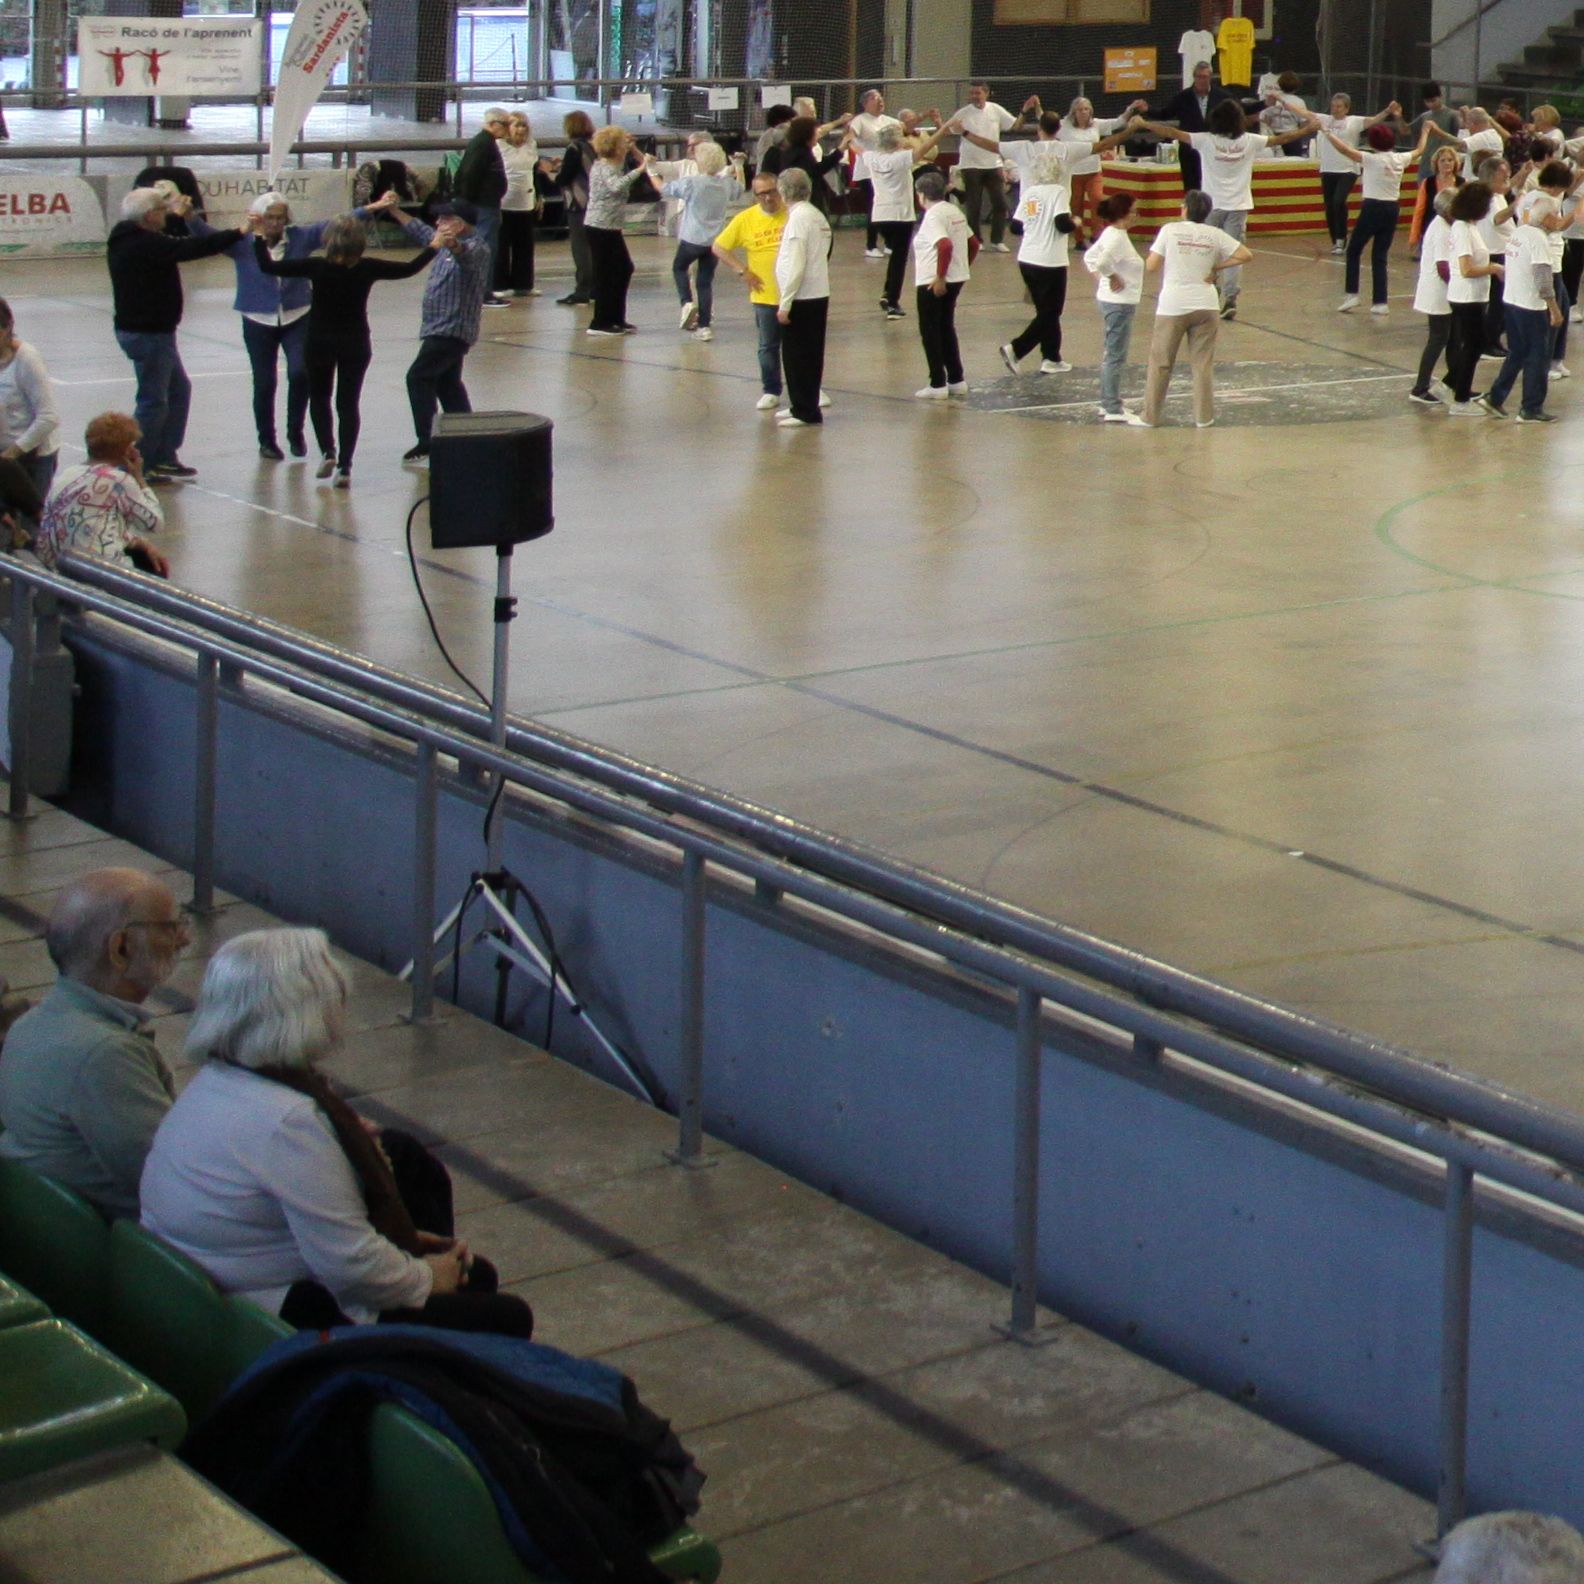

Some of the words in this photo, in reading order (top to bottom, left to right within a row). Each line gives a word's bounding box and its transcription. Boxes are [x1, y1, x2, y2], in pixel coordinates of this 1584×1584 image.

[121, 26, 157, 39] Racó
[162, 27, 180, 38] de
[184, 27, 253, 40] l'aprenent
